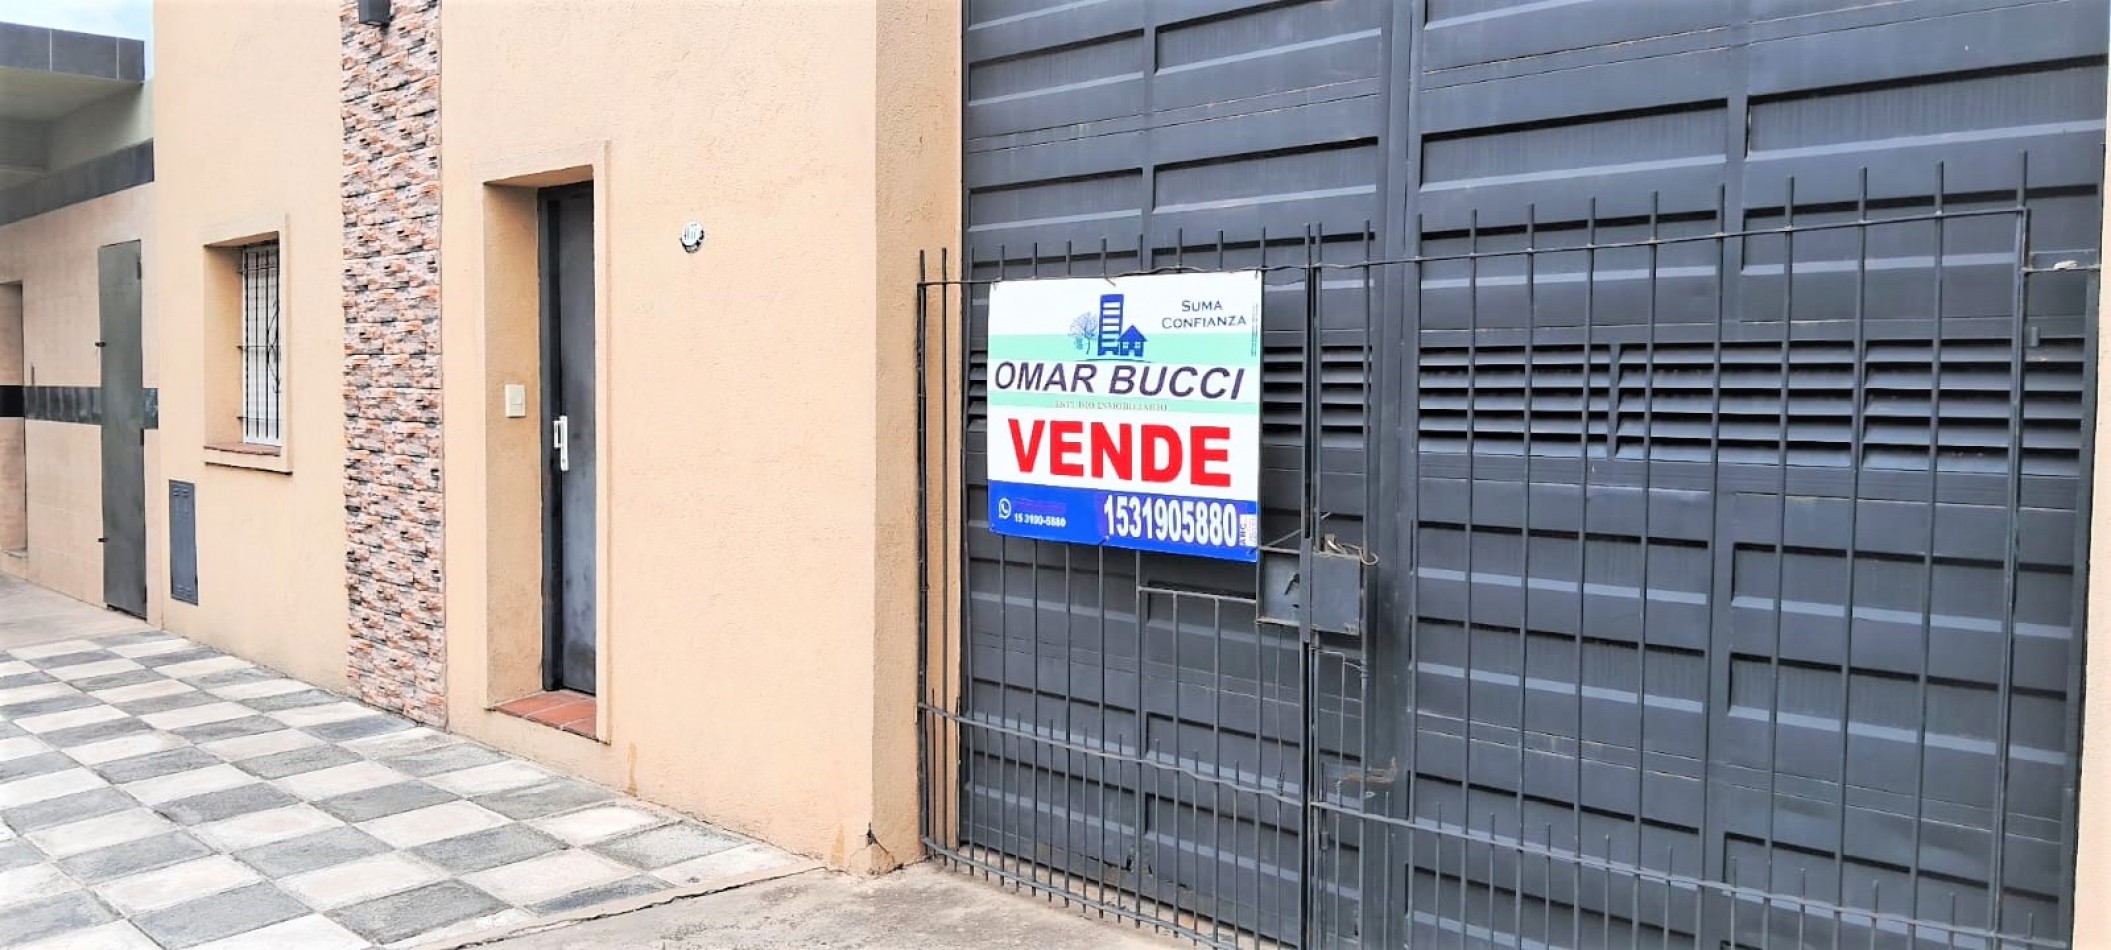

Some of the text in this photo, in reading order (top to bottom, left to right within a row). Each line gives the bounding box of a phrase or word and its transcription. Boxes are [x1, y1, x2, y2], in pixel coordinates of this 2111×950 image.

[1181, 300, 1223, 312] SUMA
[1161, 315, 1247, 329] CONFIANZA
[994, 361, 1246, 401] OMAR BUCCI
[1007, 418, 1232, 488] VENDE
[1014, 512, 1024, 523] 15
[1103, 494, 1237, 548] 1531905880
